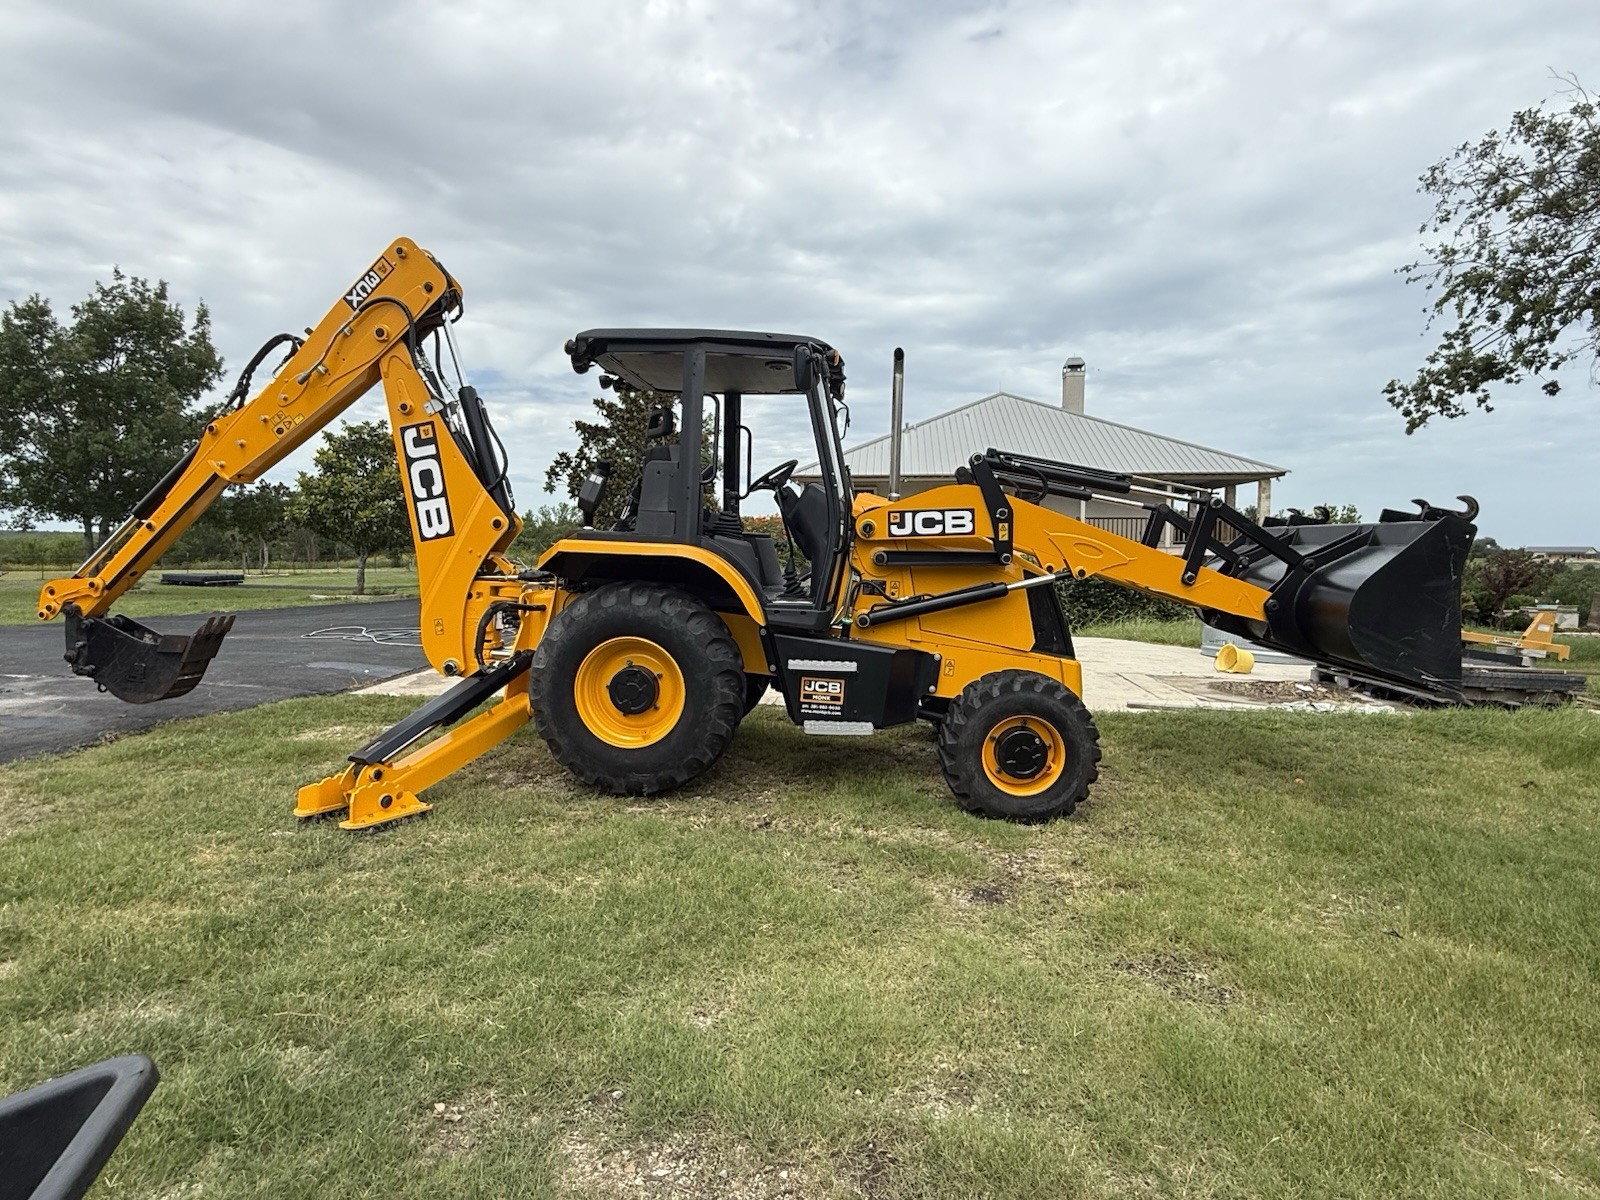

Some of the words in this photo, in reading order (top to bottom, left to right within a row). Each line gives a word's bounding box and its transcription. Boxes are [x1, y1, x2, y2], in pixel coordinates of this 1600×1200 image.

[346, 271, 381, 308] 3CX
[404, 427, 451, 539] JCB
[890, 510, 974, 536] JCB
[804, 680, 841, 694] JCB
